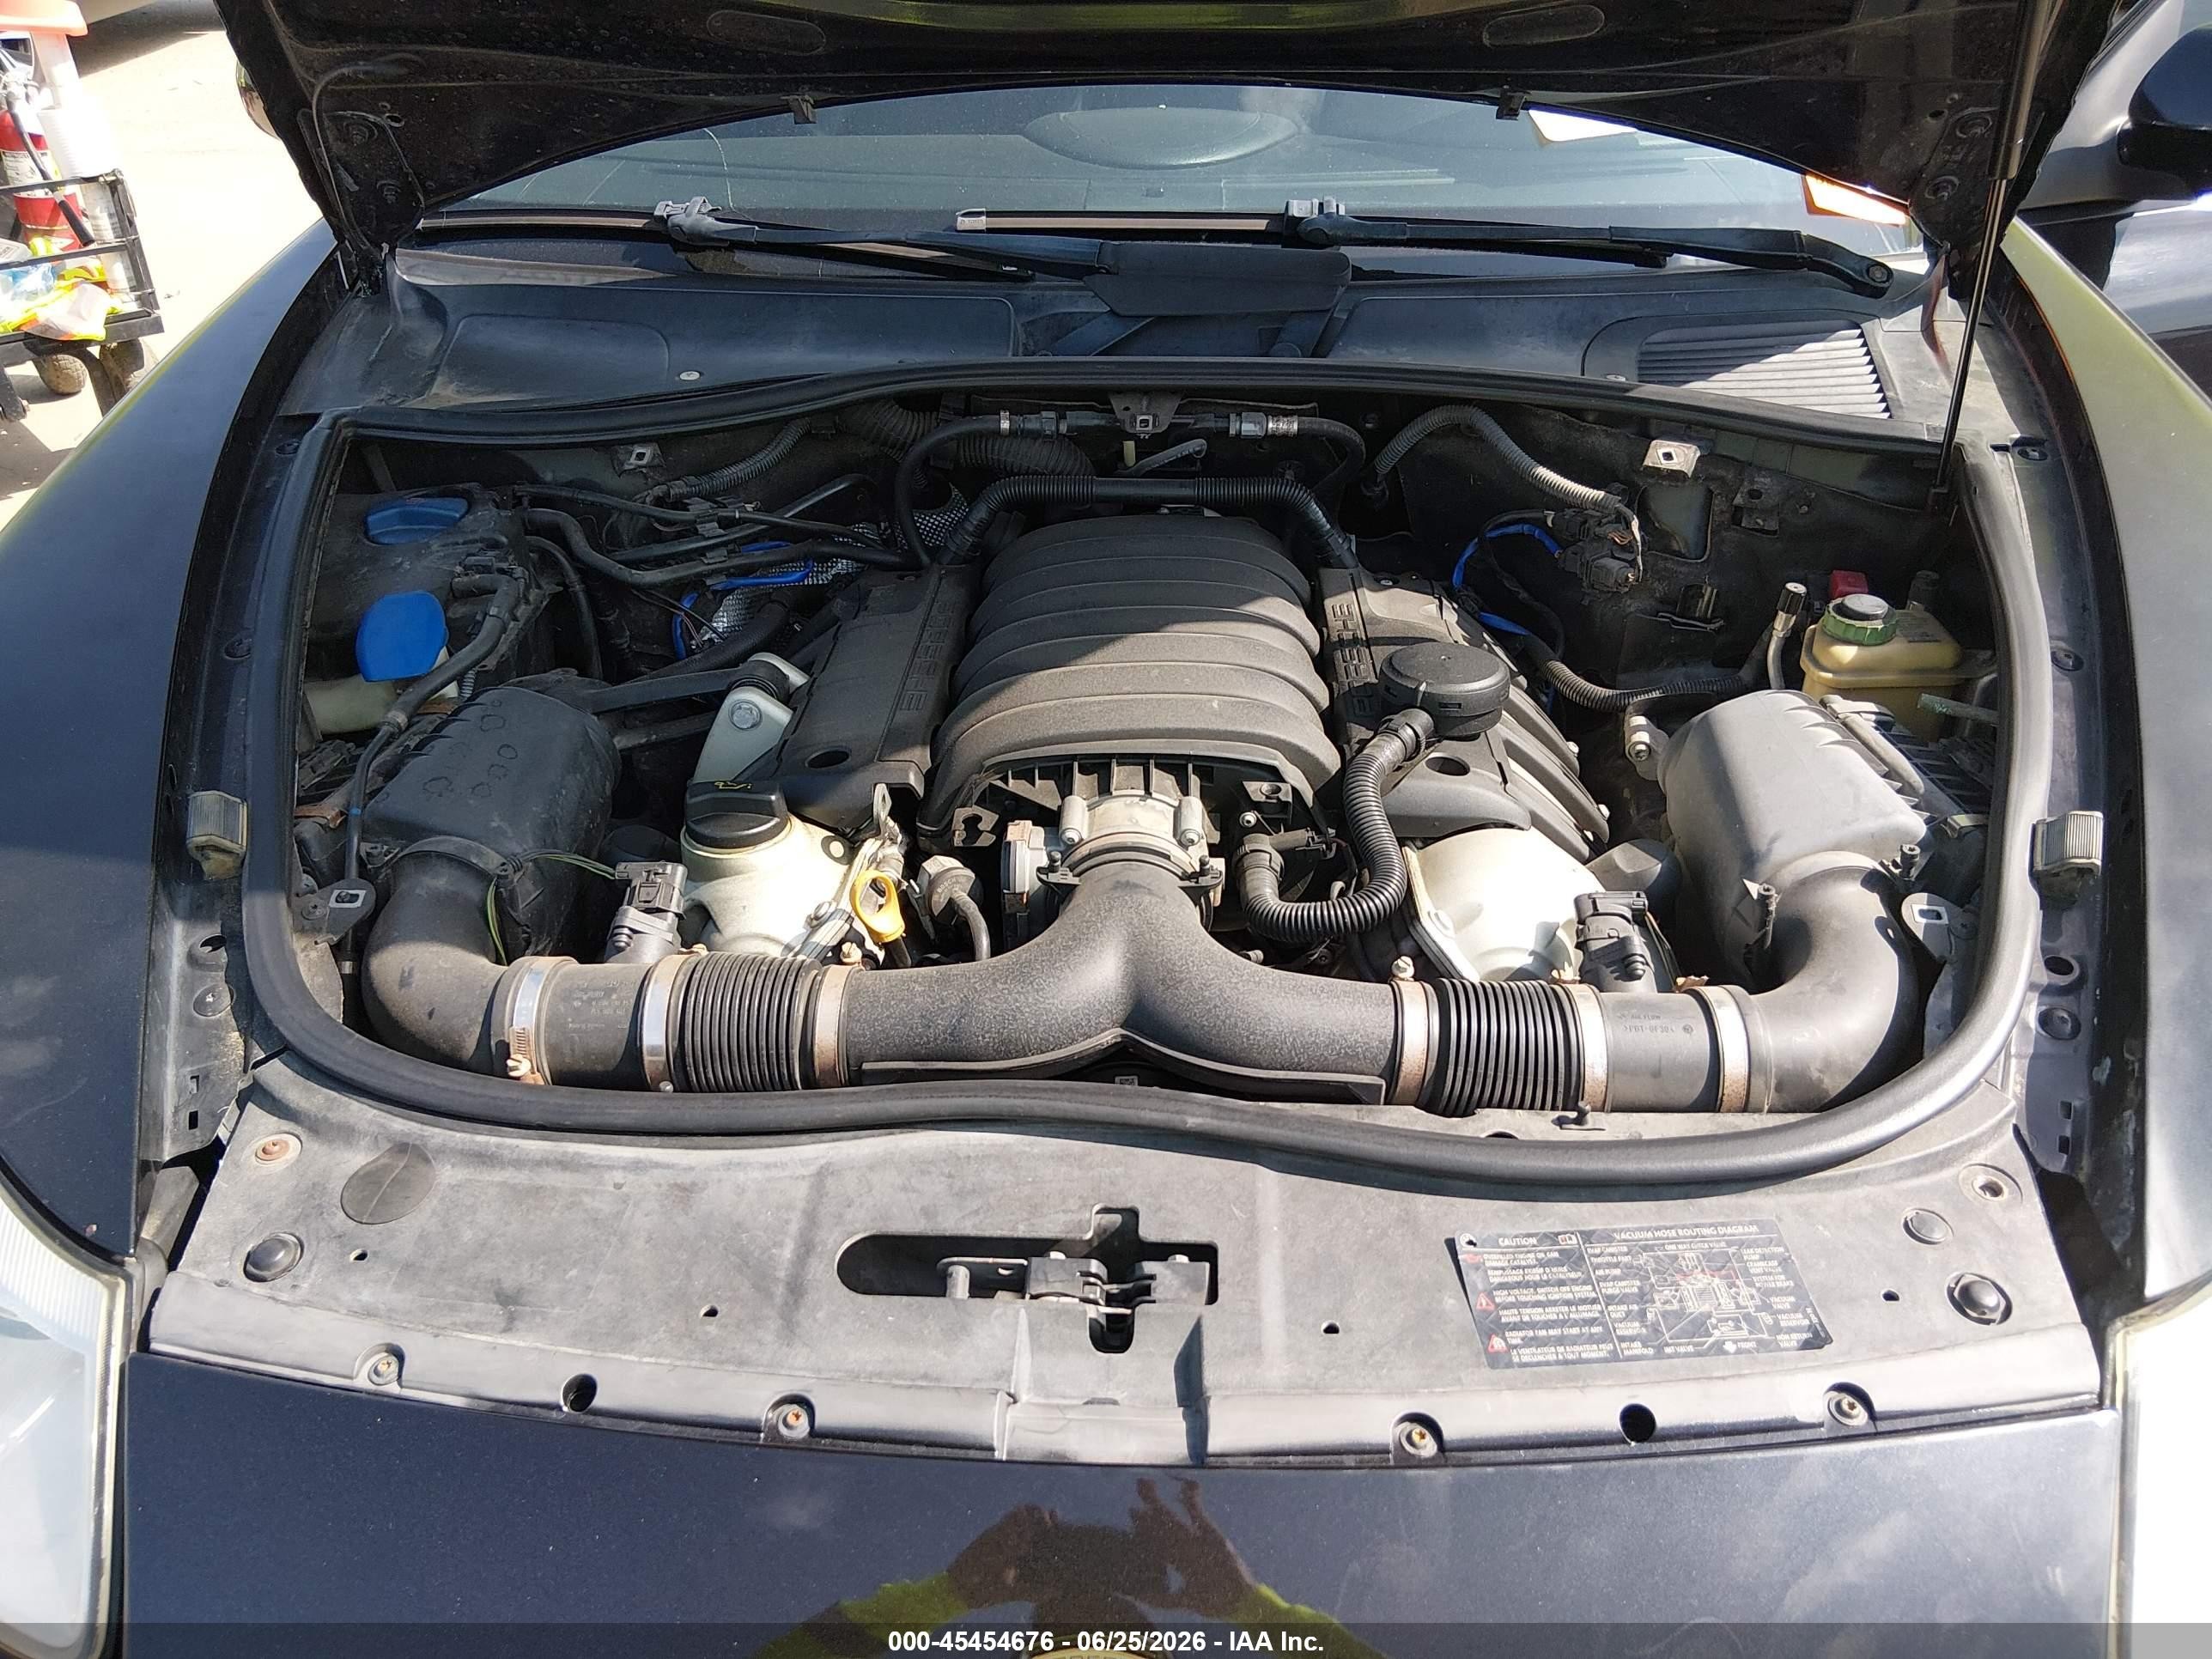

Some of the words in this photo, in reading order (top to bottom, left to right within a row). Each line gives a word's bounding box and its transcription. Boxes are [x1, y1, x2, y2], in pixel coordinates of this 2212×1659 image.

[899, 601, 955, 712] PORSCHE
[1332, 603, 1375, 718] PORSCHE
[937, 877, 957, 894] BOSCH
[1498, 1237, 1537, 1246] CAUTION
